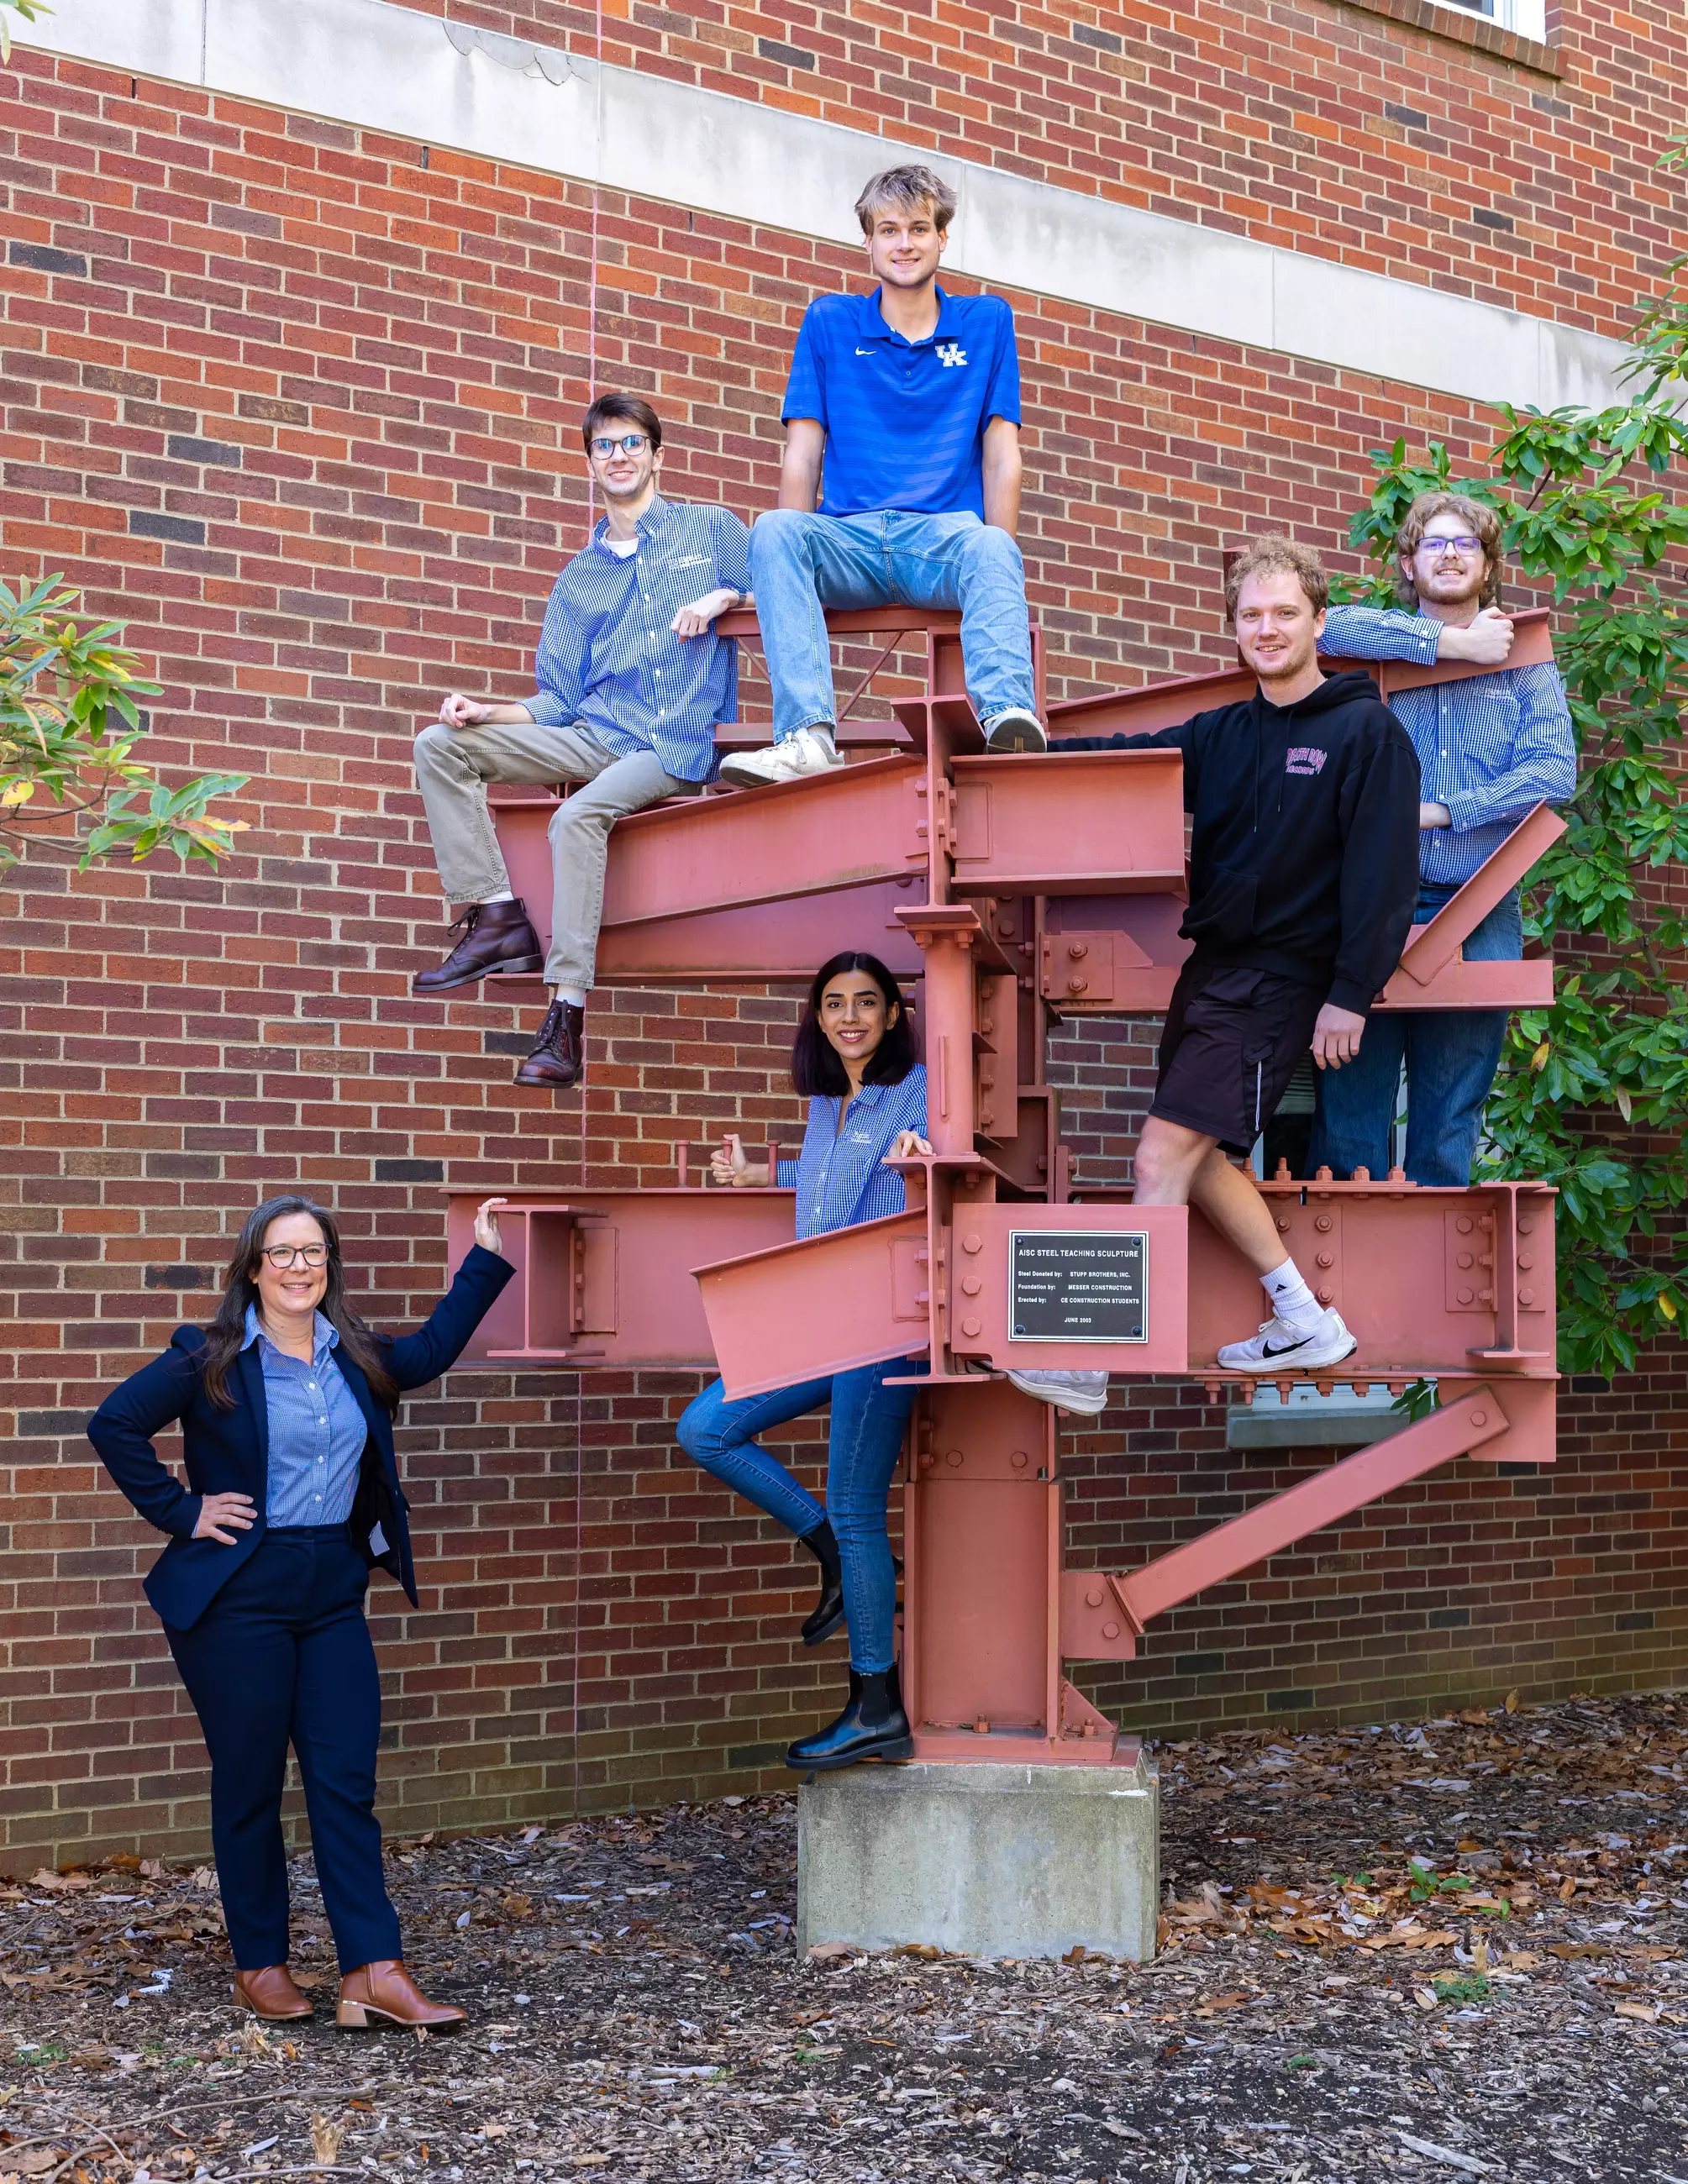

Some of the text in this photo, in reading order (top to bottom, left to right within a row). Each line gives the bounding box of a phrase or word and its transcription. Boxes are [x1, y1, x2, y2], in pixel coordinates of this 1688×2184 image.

[935, 344, 967, 367] UK
[1286, 748, 1327, 774] DEATH ROW
[1286, 765, 1314, 774] RECORDS
